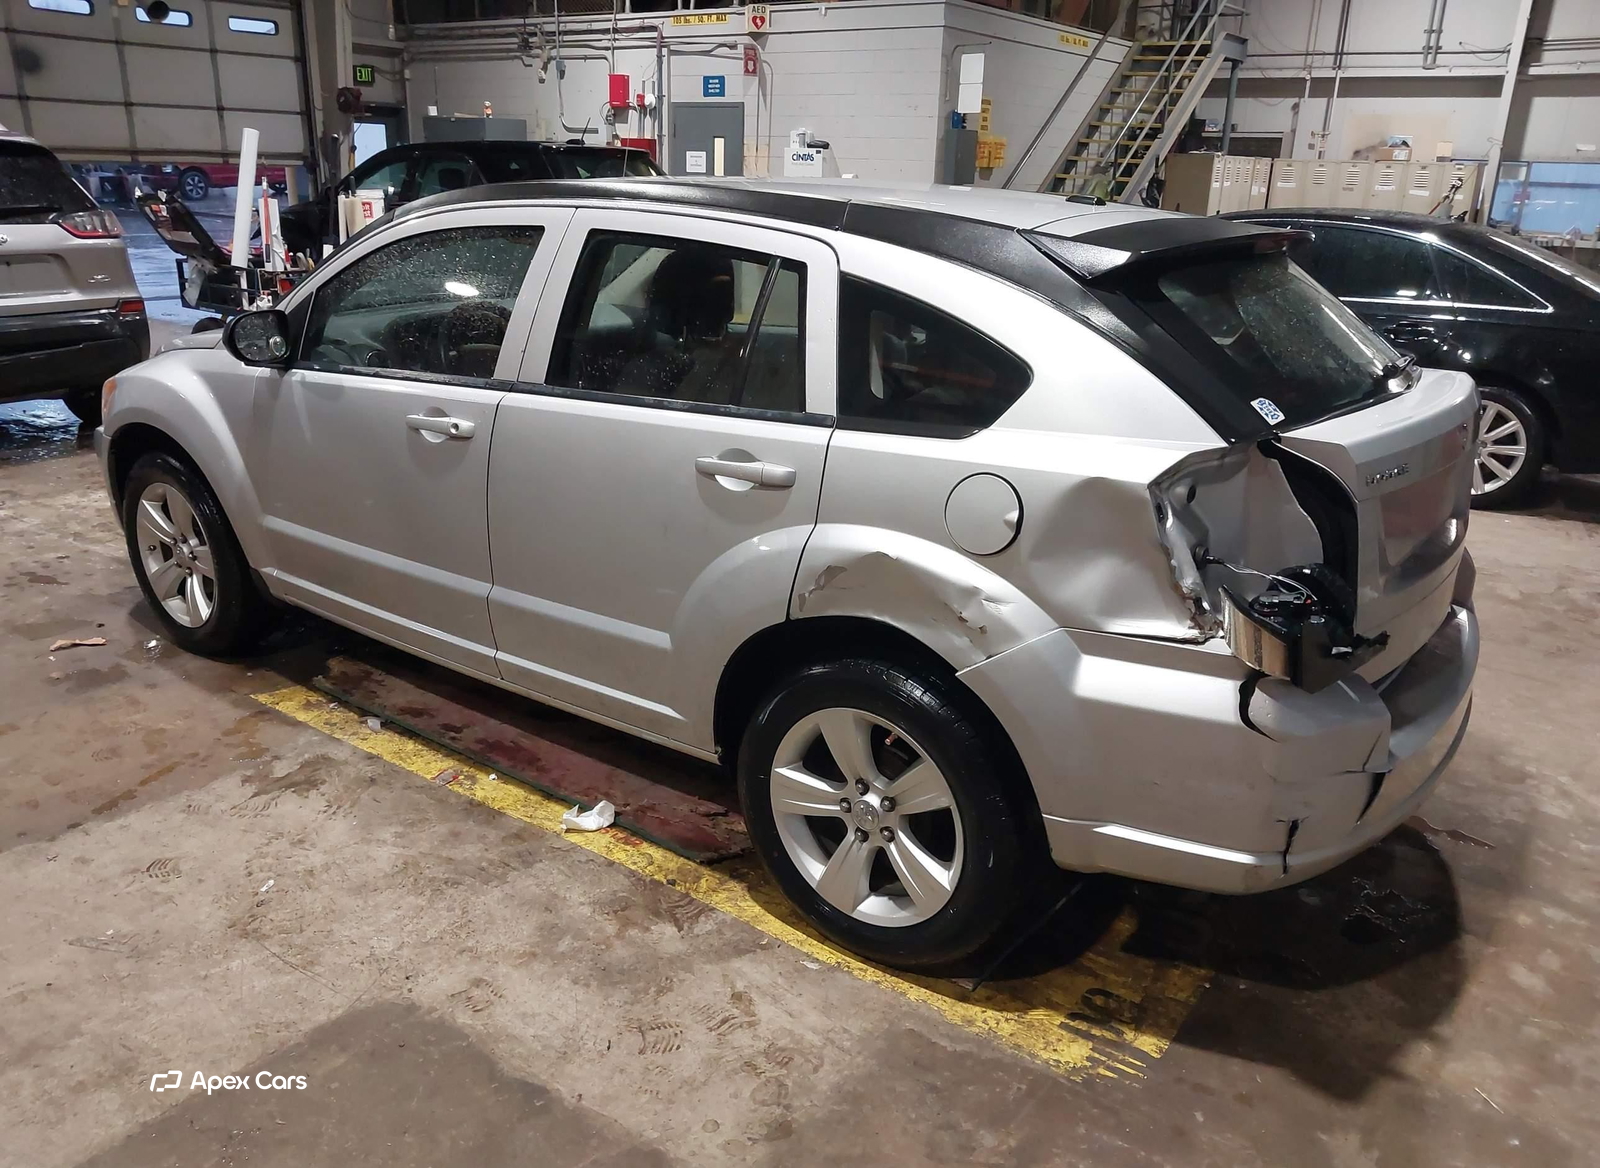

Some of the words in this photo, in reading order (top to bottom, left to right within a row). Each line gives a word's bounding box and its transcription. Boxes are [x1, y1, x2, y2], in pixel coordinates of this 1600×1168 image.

[751, 5, 767, 14] AED
[716, 14, 728, 22] MAX
[356, 67, 373, 82] EXIT
[791, 151, 815, 162] CINTAS
